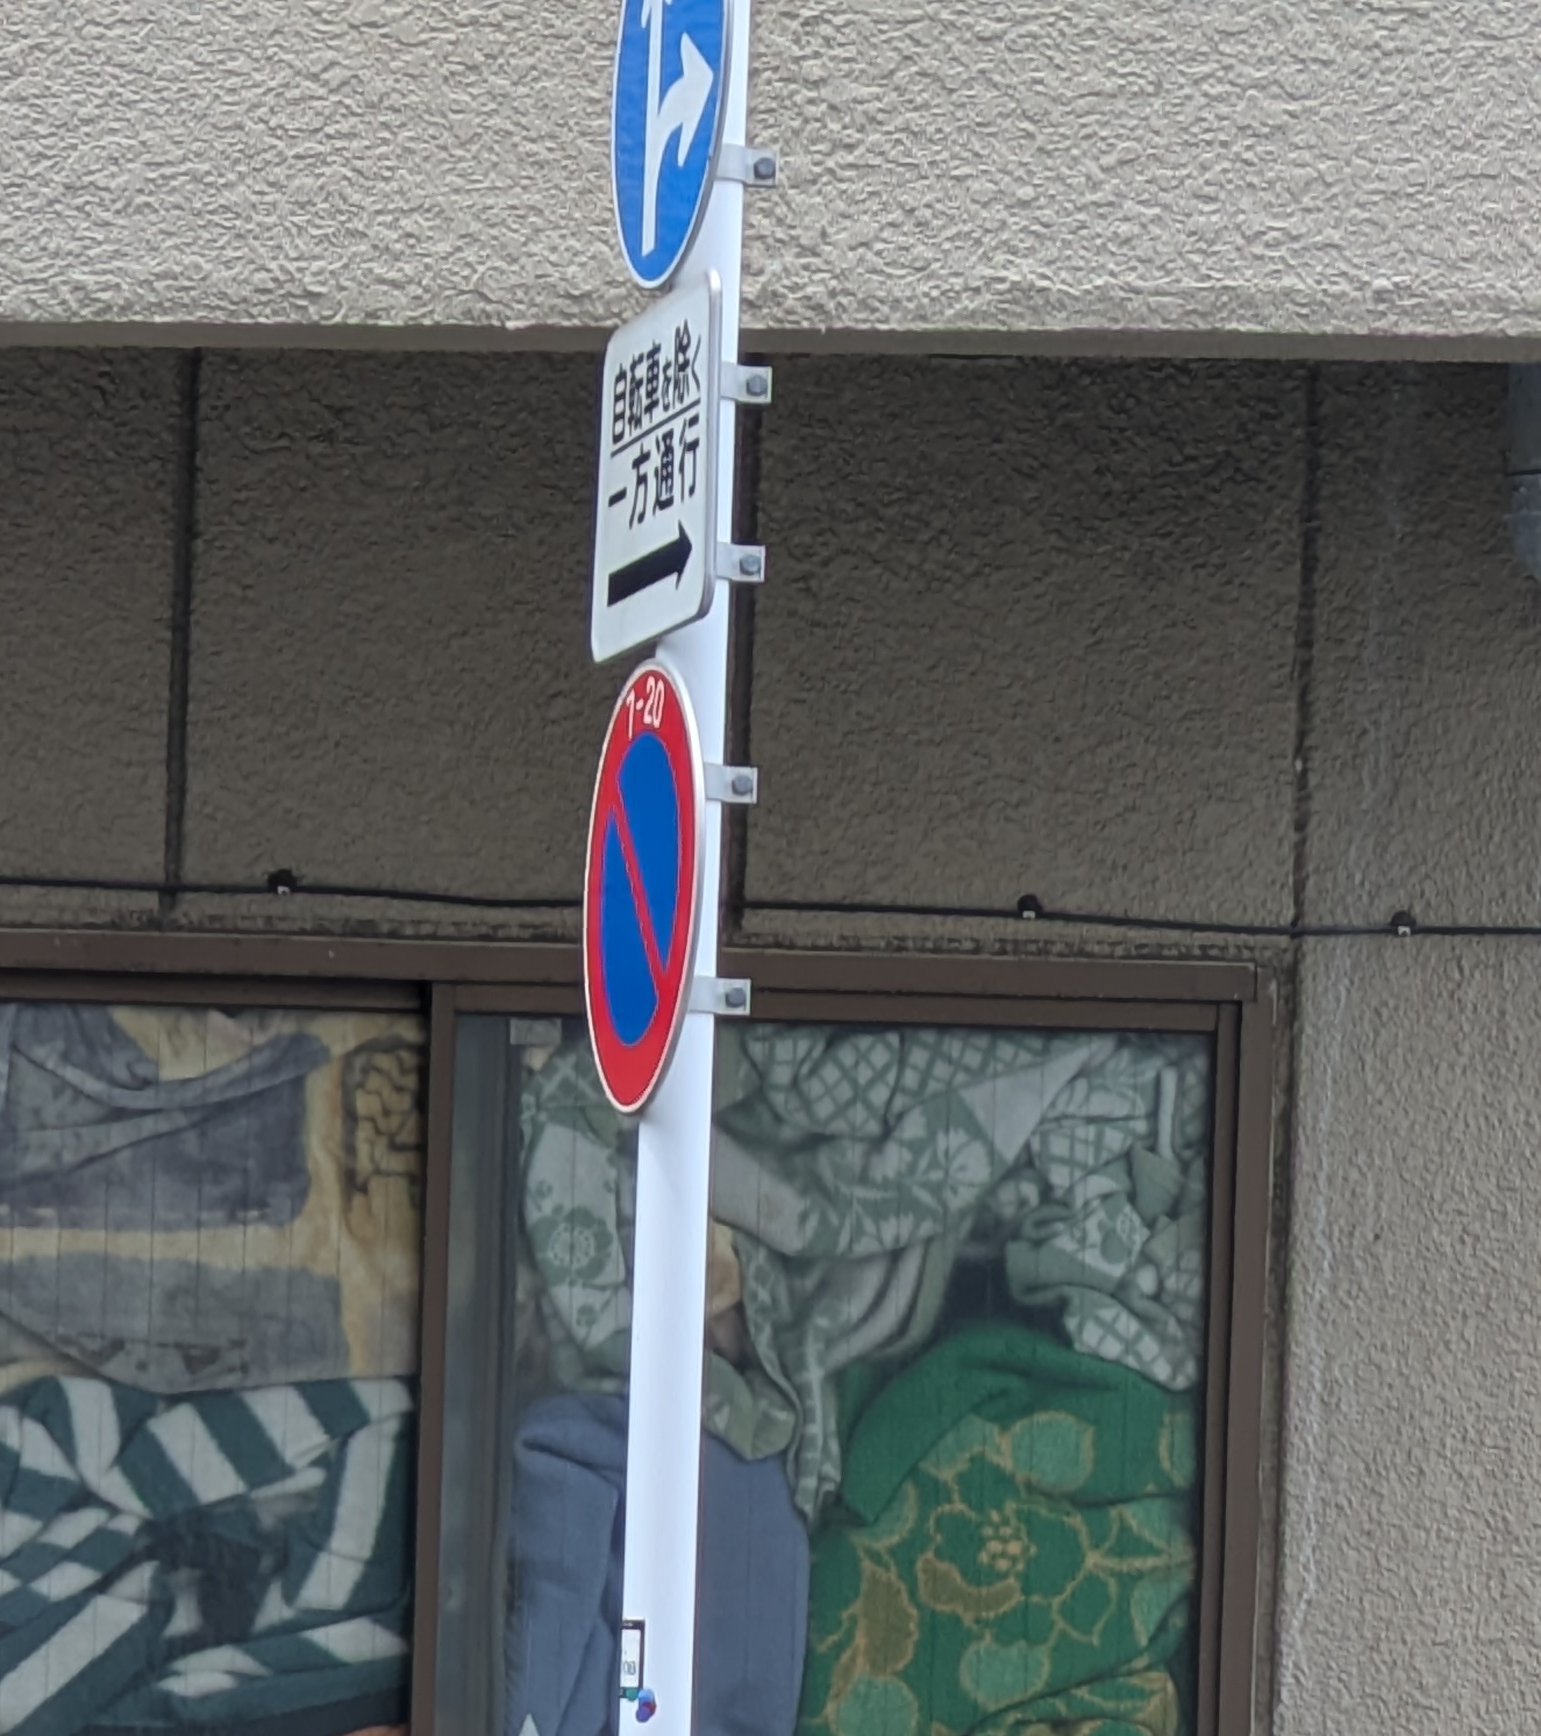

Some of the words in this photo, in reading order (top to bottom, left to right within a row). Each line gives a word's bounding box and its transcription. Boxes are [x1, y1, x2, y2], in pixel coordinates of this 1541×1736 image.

[612, 319, 702, 445] 自転車を除く
[608, 413, 700, 530] 一方通行
